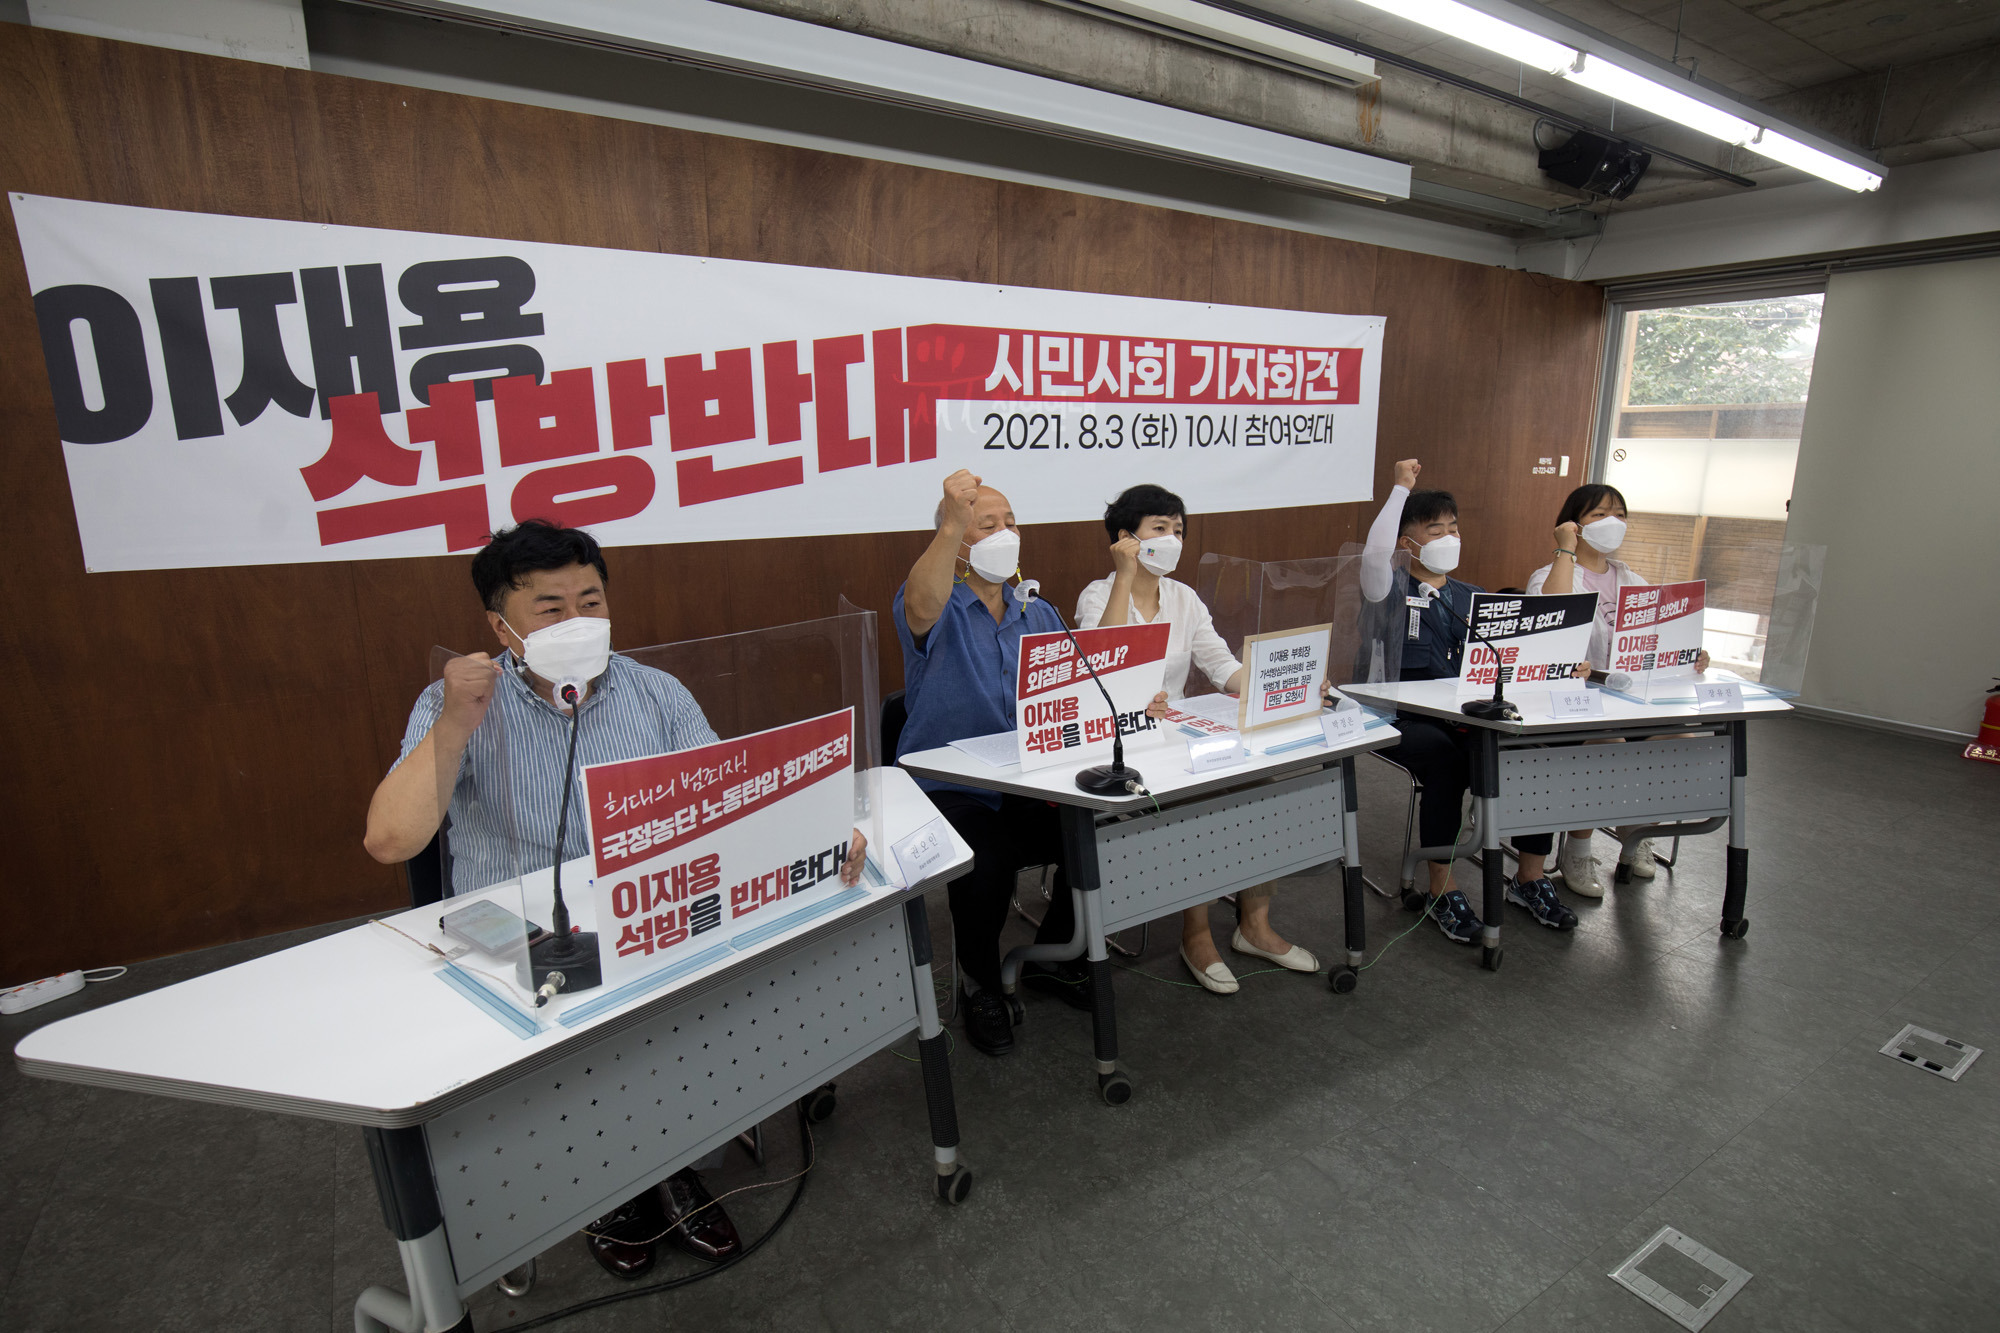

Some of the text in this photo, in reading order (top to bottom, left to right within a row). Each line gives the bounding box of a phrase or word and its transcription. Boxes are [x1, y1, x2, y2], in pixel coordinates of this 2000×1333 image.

[33, 256, 546, 444] 이재용
[984, 333, 1339, 401] 시민사회 기자회견
[300, 324, 937, 553] 석방반대
[983, 412, 1335, 451] 2021. 8.3 (화) 10시 참여연대
[1478, 599, 1523, 620] 국민은
[1622, 596, 1689, 628] 외침을 잊었나?
[1624, 588, 1660, 610] 촛불의
[1475, 609, 1566, 639] 공감한 적 없다!
[1028, 636, 1076, 669] 촛불의
[1268, 645, 1311, 663] 이재용 부회장
[1469, 646, 1520, 666] 이재용
[1617, 633, 1659, 653] 이재용
[1026, 644, 1129, 694] 외침을 잊었나?
[1305, 659, 1318, 672] 관련
[1466, 665, 1514, 686] 석방을
[1615, 652, 1656, 673] 석방을
[1023, 696, 1080, 728] 이재용
[1268, 688, 1304, 707] 면담 요청서
[1025, 722, 1081, 755] 석방을
[601, 733, 850, 861] 국정농단 노동탄압 회계조작
[603, 749, 748, 820] 희대의 범죄자!
[611, 852, 721, 919] 이재용
[615, 893, 722, 958] 석방을
